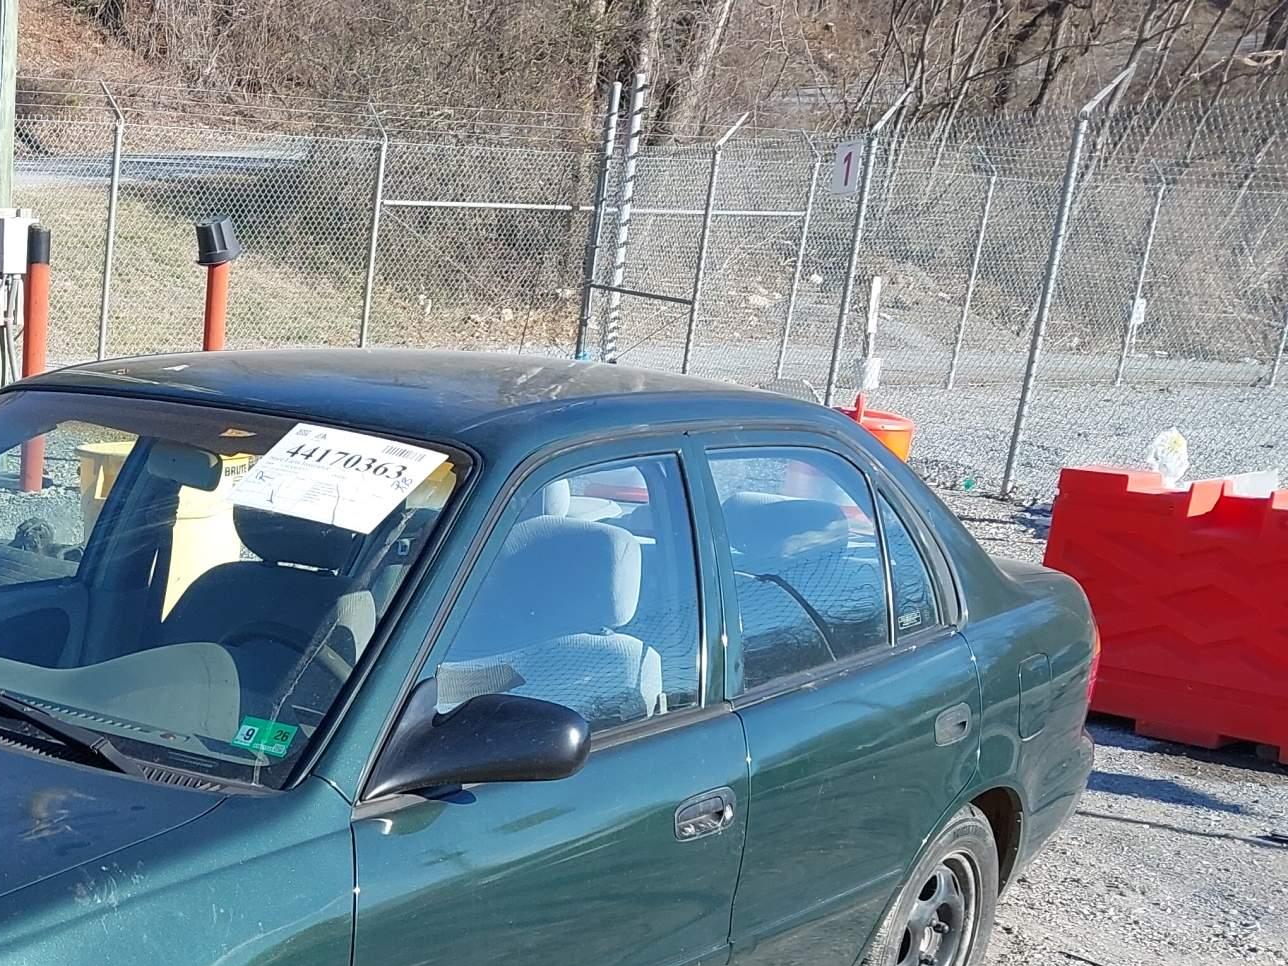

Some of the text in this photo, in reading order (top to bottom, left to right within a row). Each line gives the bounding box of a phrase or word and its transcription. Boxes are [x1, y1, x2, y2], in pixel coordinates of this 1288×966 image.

[843, 151, 853, 187] 1
[224, 463, 248, 477] BRUTE
[286, 444, 408, 480] 44170363
[243, 728, 290, 742] 9 26
